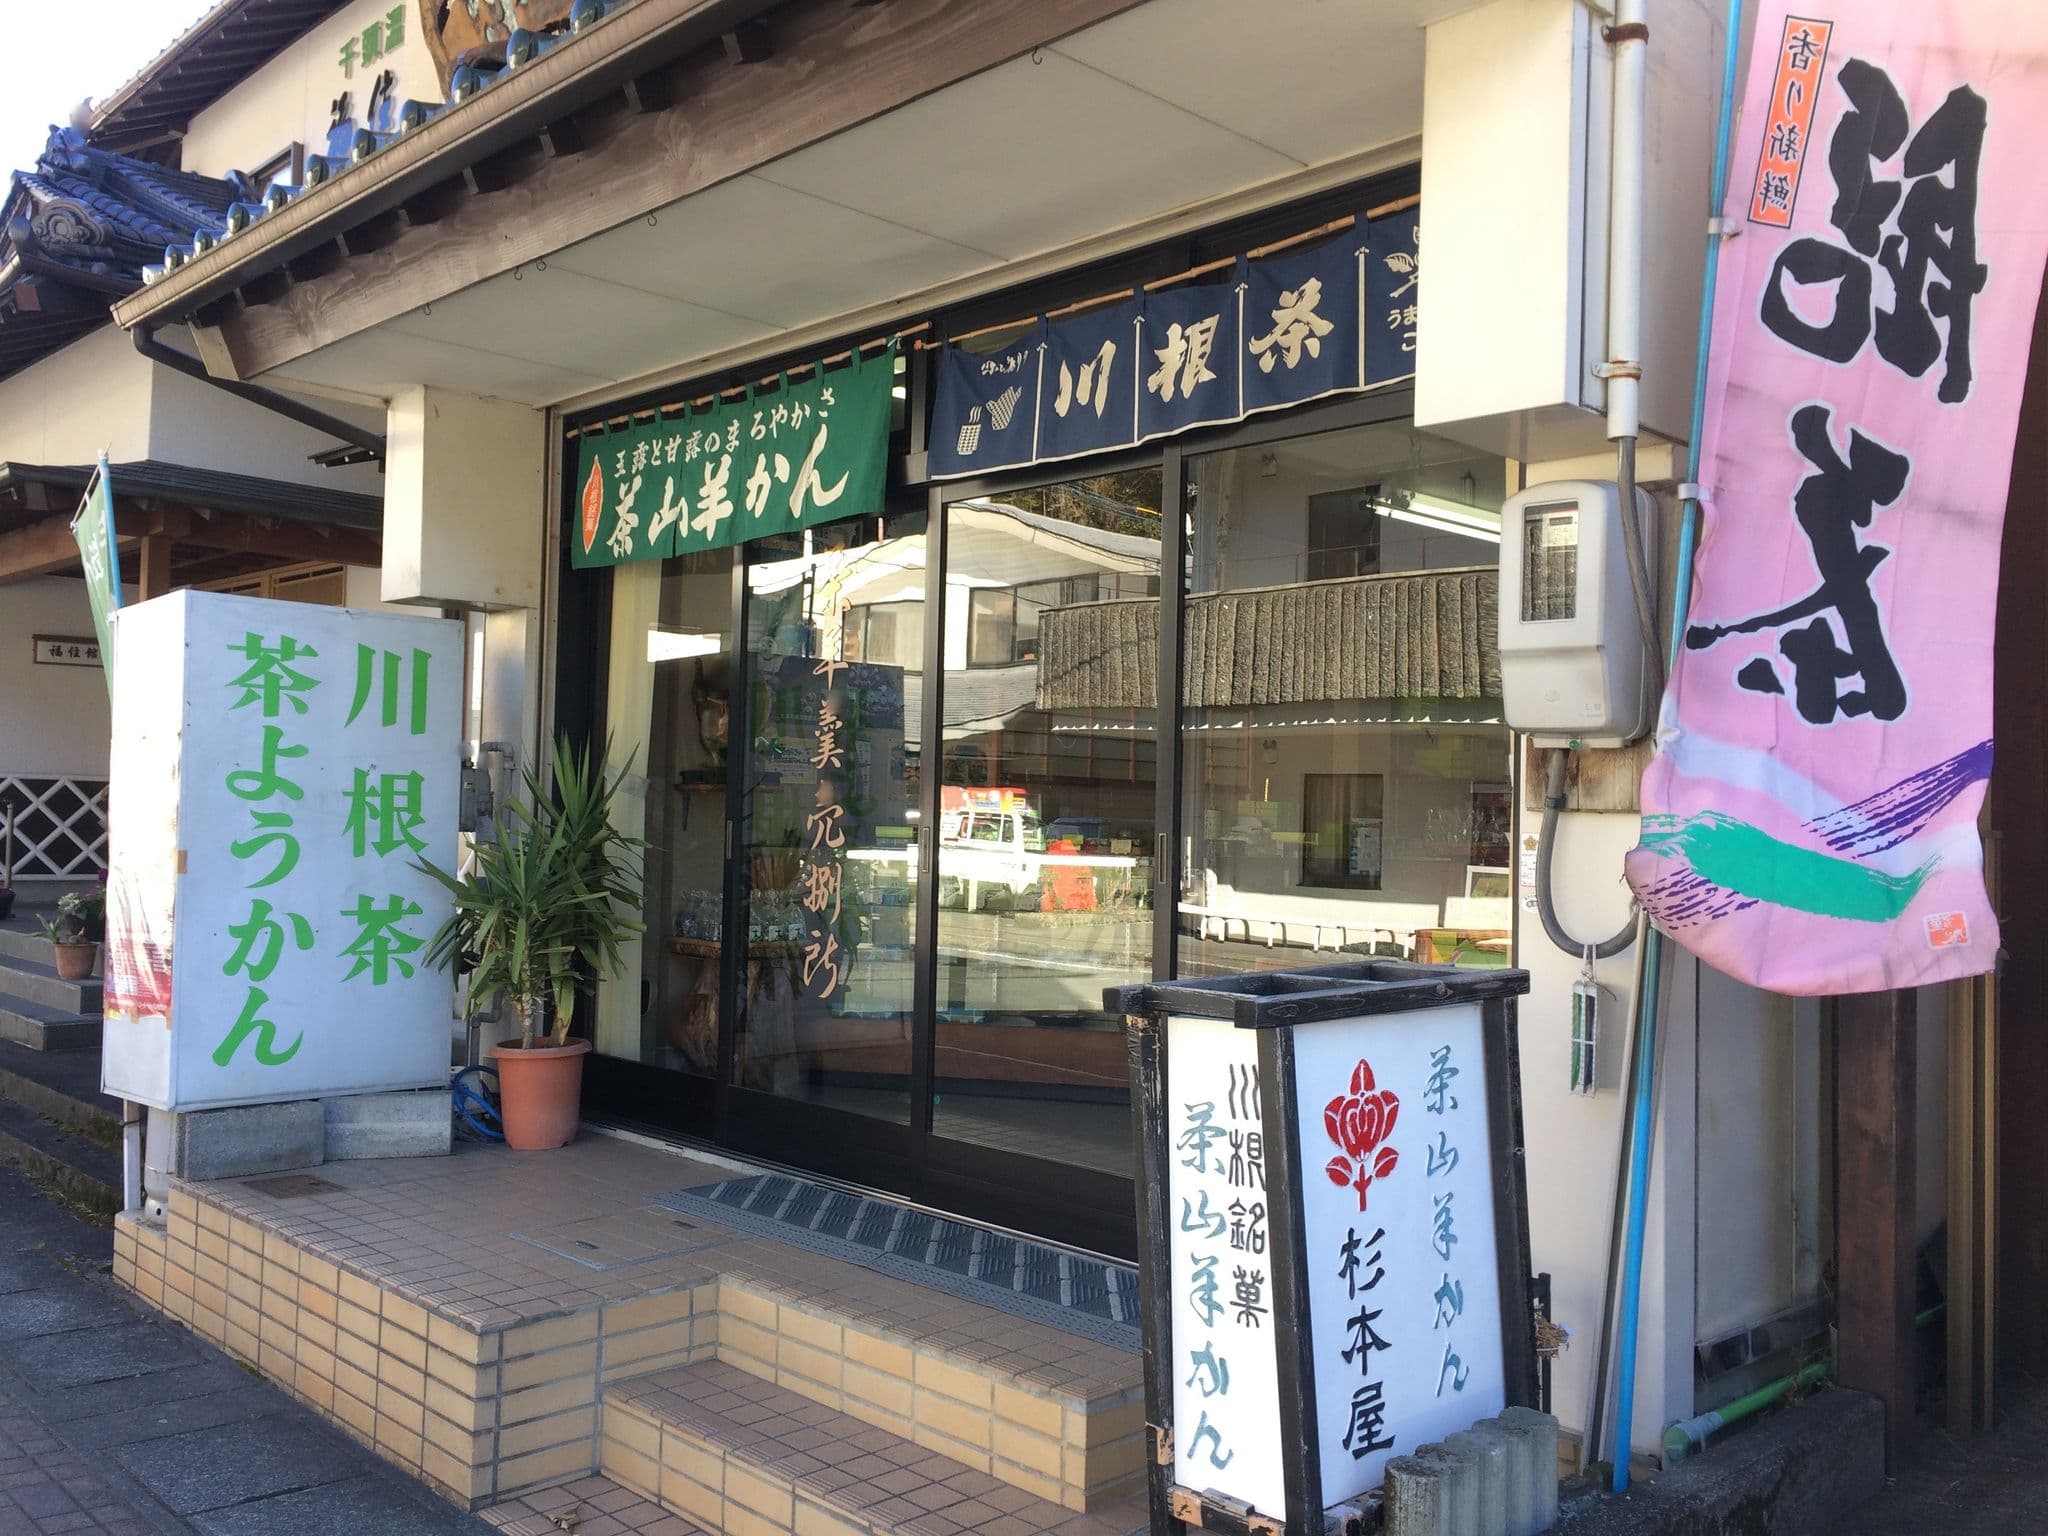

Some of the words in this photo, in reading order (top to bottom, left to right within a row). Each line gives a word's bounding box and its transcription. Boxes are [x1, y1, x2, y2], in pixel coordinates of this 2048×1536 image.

[606, 423, 850, 558] 茶山羊かん
[1054, 277, 1334, 418] 川根茶
[212, 631, 322, 1068] 茶ようかん
[336, 642, 433, 986] 川根茶
[1176, 1101, 1235, 1472] 茶山羊かん
[1227, 1063, 1269, 1329] 川根銘菓
[1337, 1227, 1396, 1461] 杉本屋
[1422, 1045, 1470, 1398] 茶山羊かん
